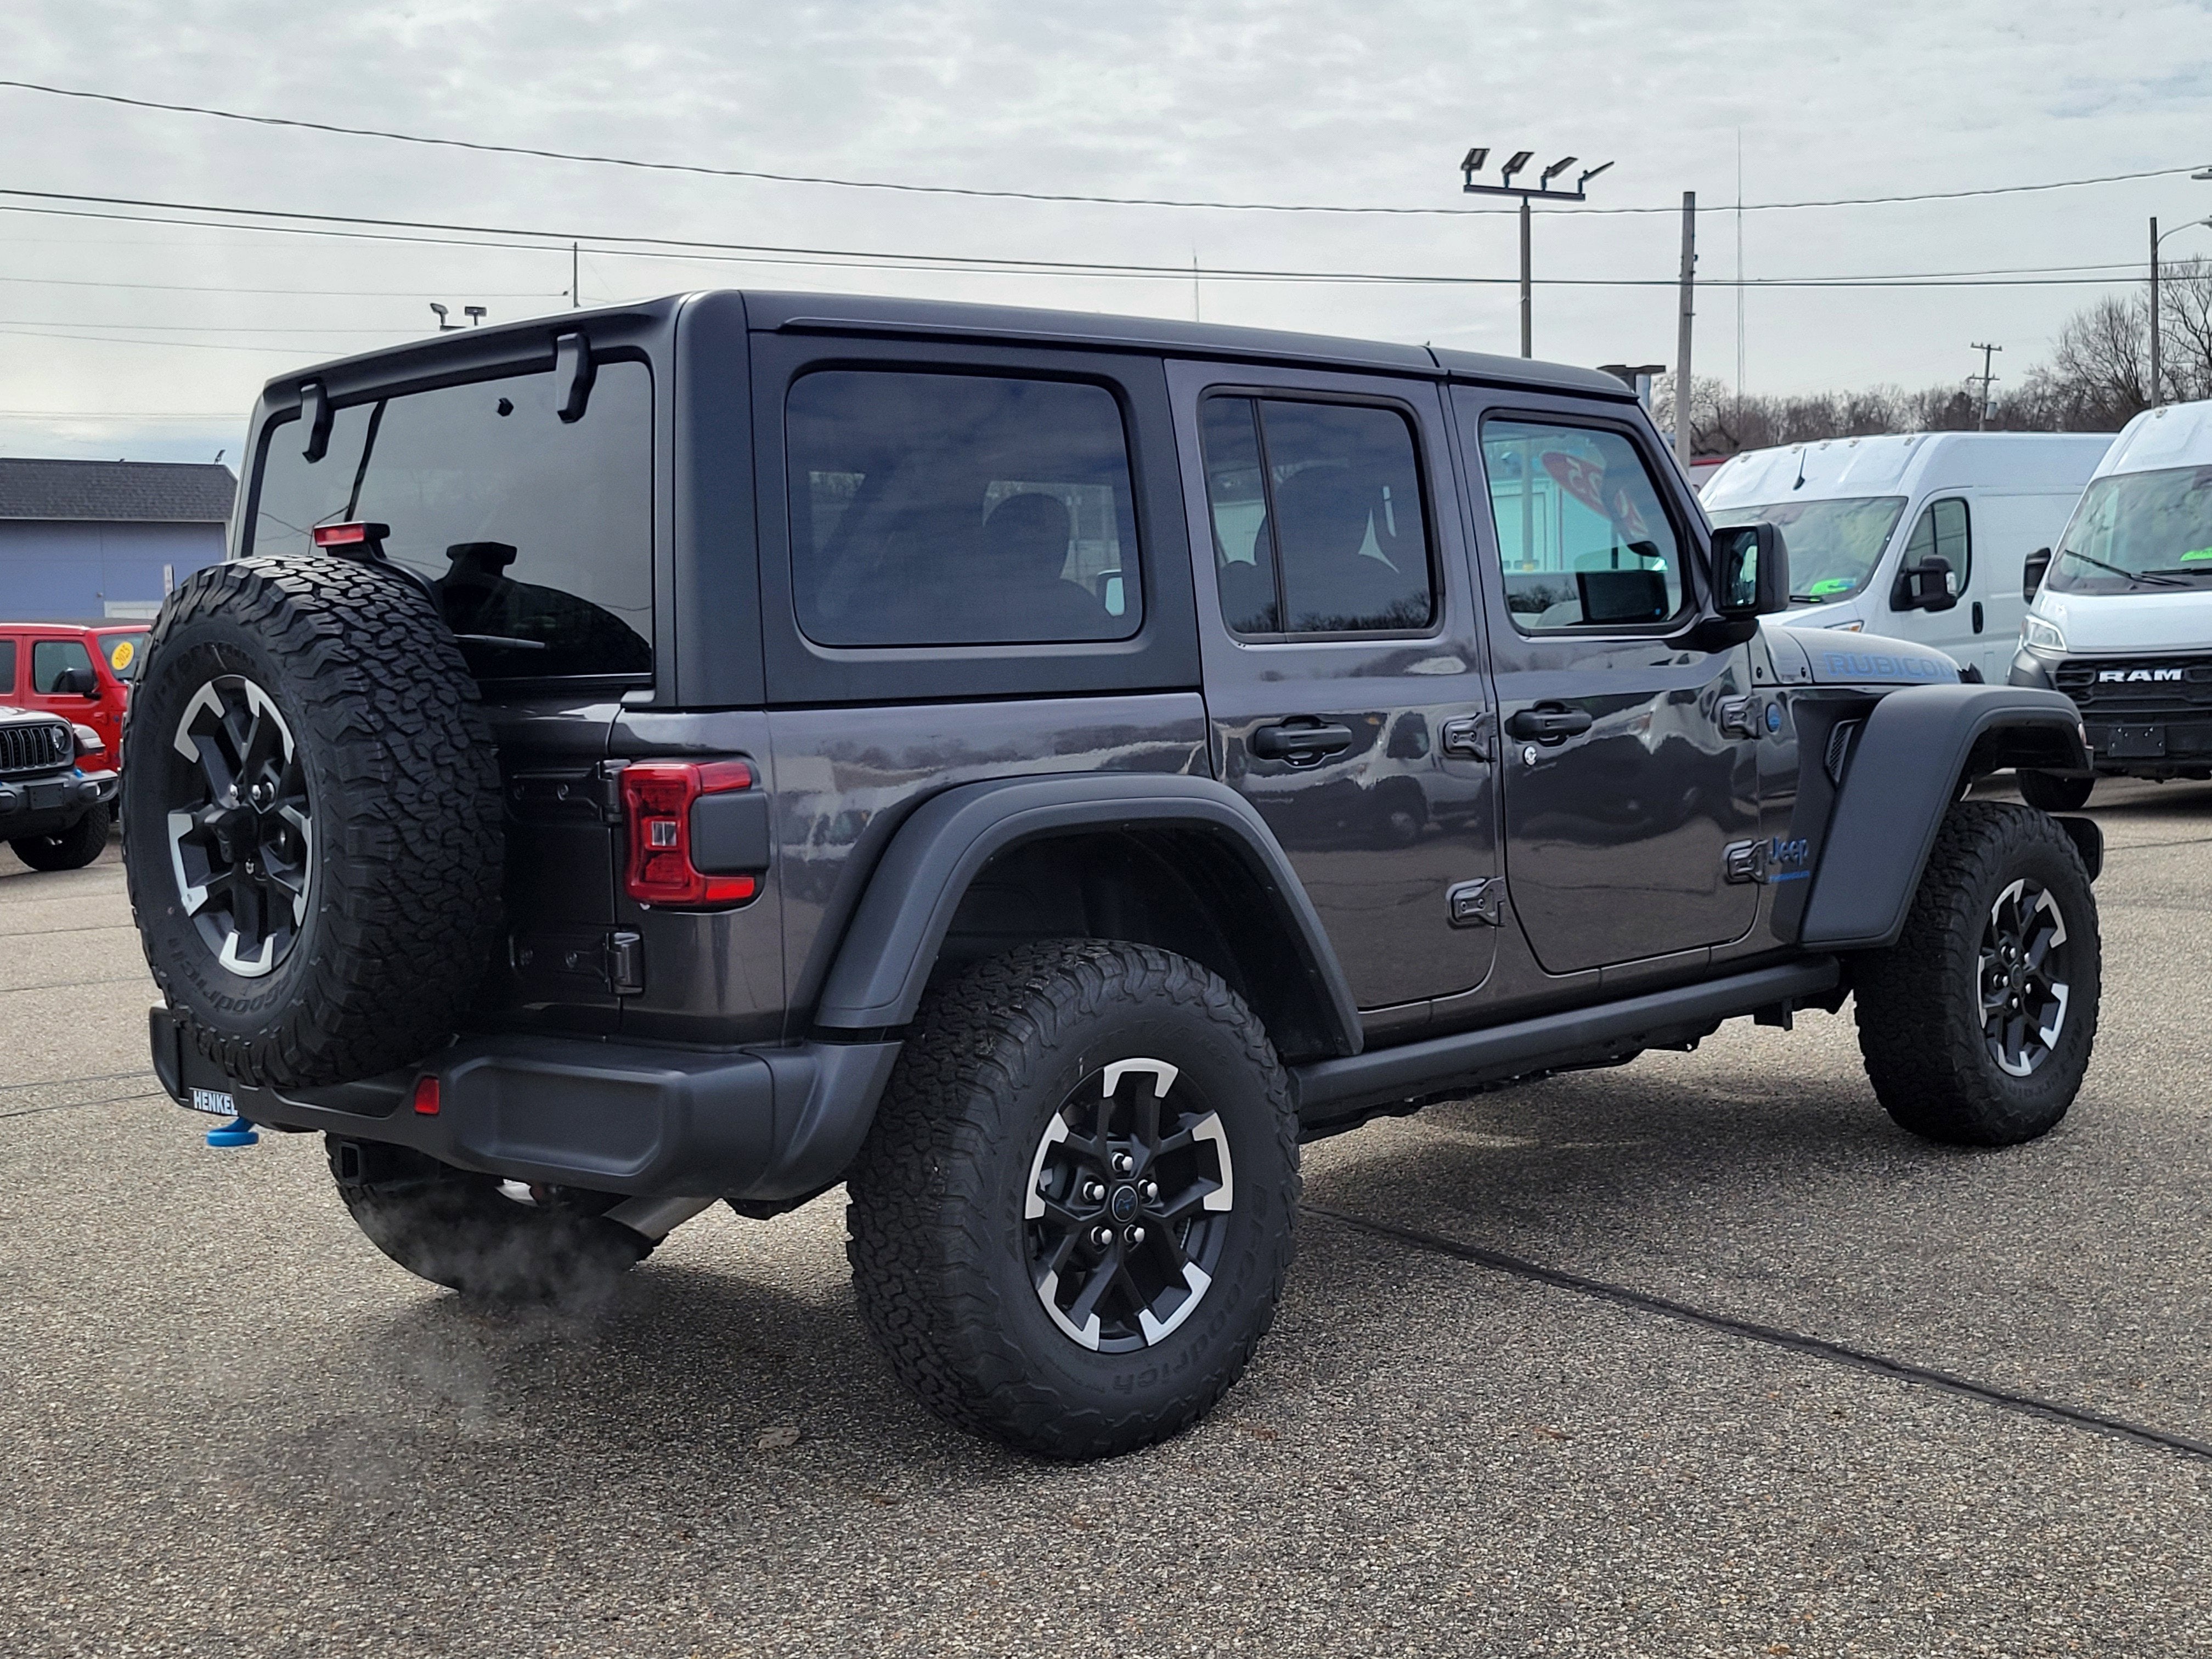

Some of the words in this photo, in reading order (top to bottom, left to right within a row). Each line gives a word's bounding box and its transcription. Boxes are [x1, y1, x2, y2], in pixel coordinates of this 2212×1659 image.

[1823, 652, 1957, 678] RUBICON
[2098, 668, 2182, 682] RAM
[1769, 836, 1809, 867] Jeep
[193, 1090, 239, 1115] HENKEL
